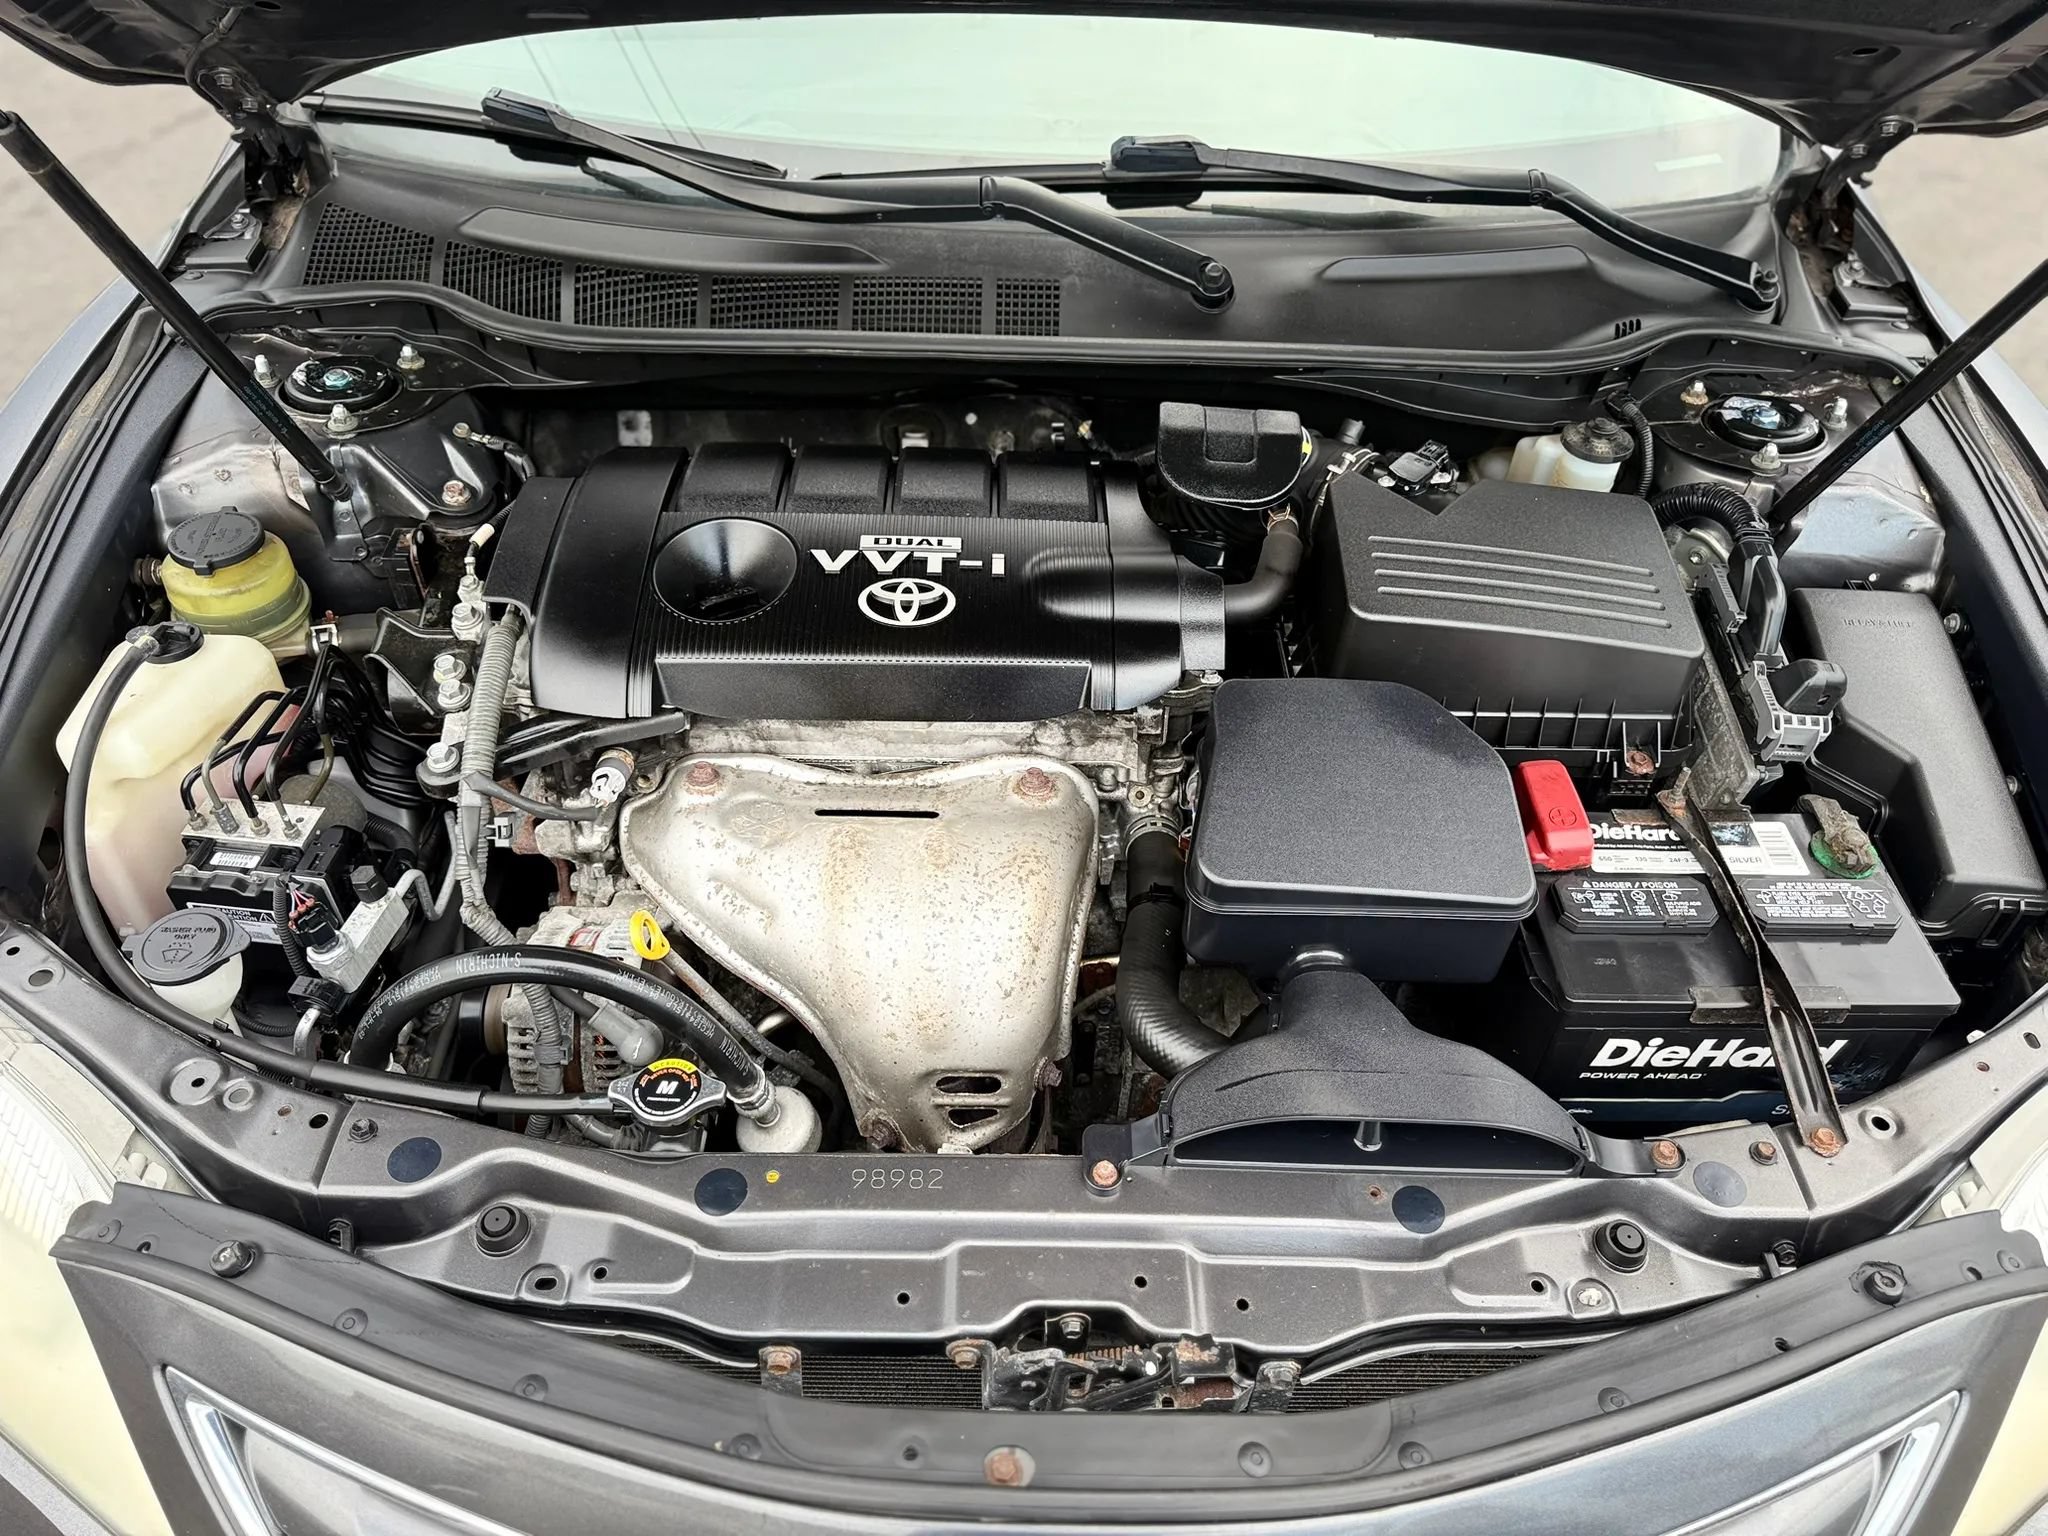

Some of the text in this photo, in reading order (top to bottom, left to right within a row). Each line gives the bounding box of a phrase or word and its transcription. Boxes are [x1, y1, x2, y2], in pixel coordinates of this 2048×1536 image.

[873, 537, 953, 547] DUAL
[1728, 856, 1763, 864] SILVER
[1591, 881, 1633, 889] DANGER
[1642, 881, 1678, 889] POISON
[851, 1168, 944, 1189] 98982
